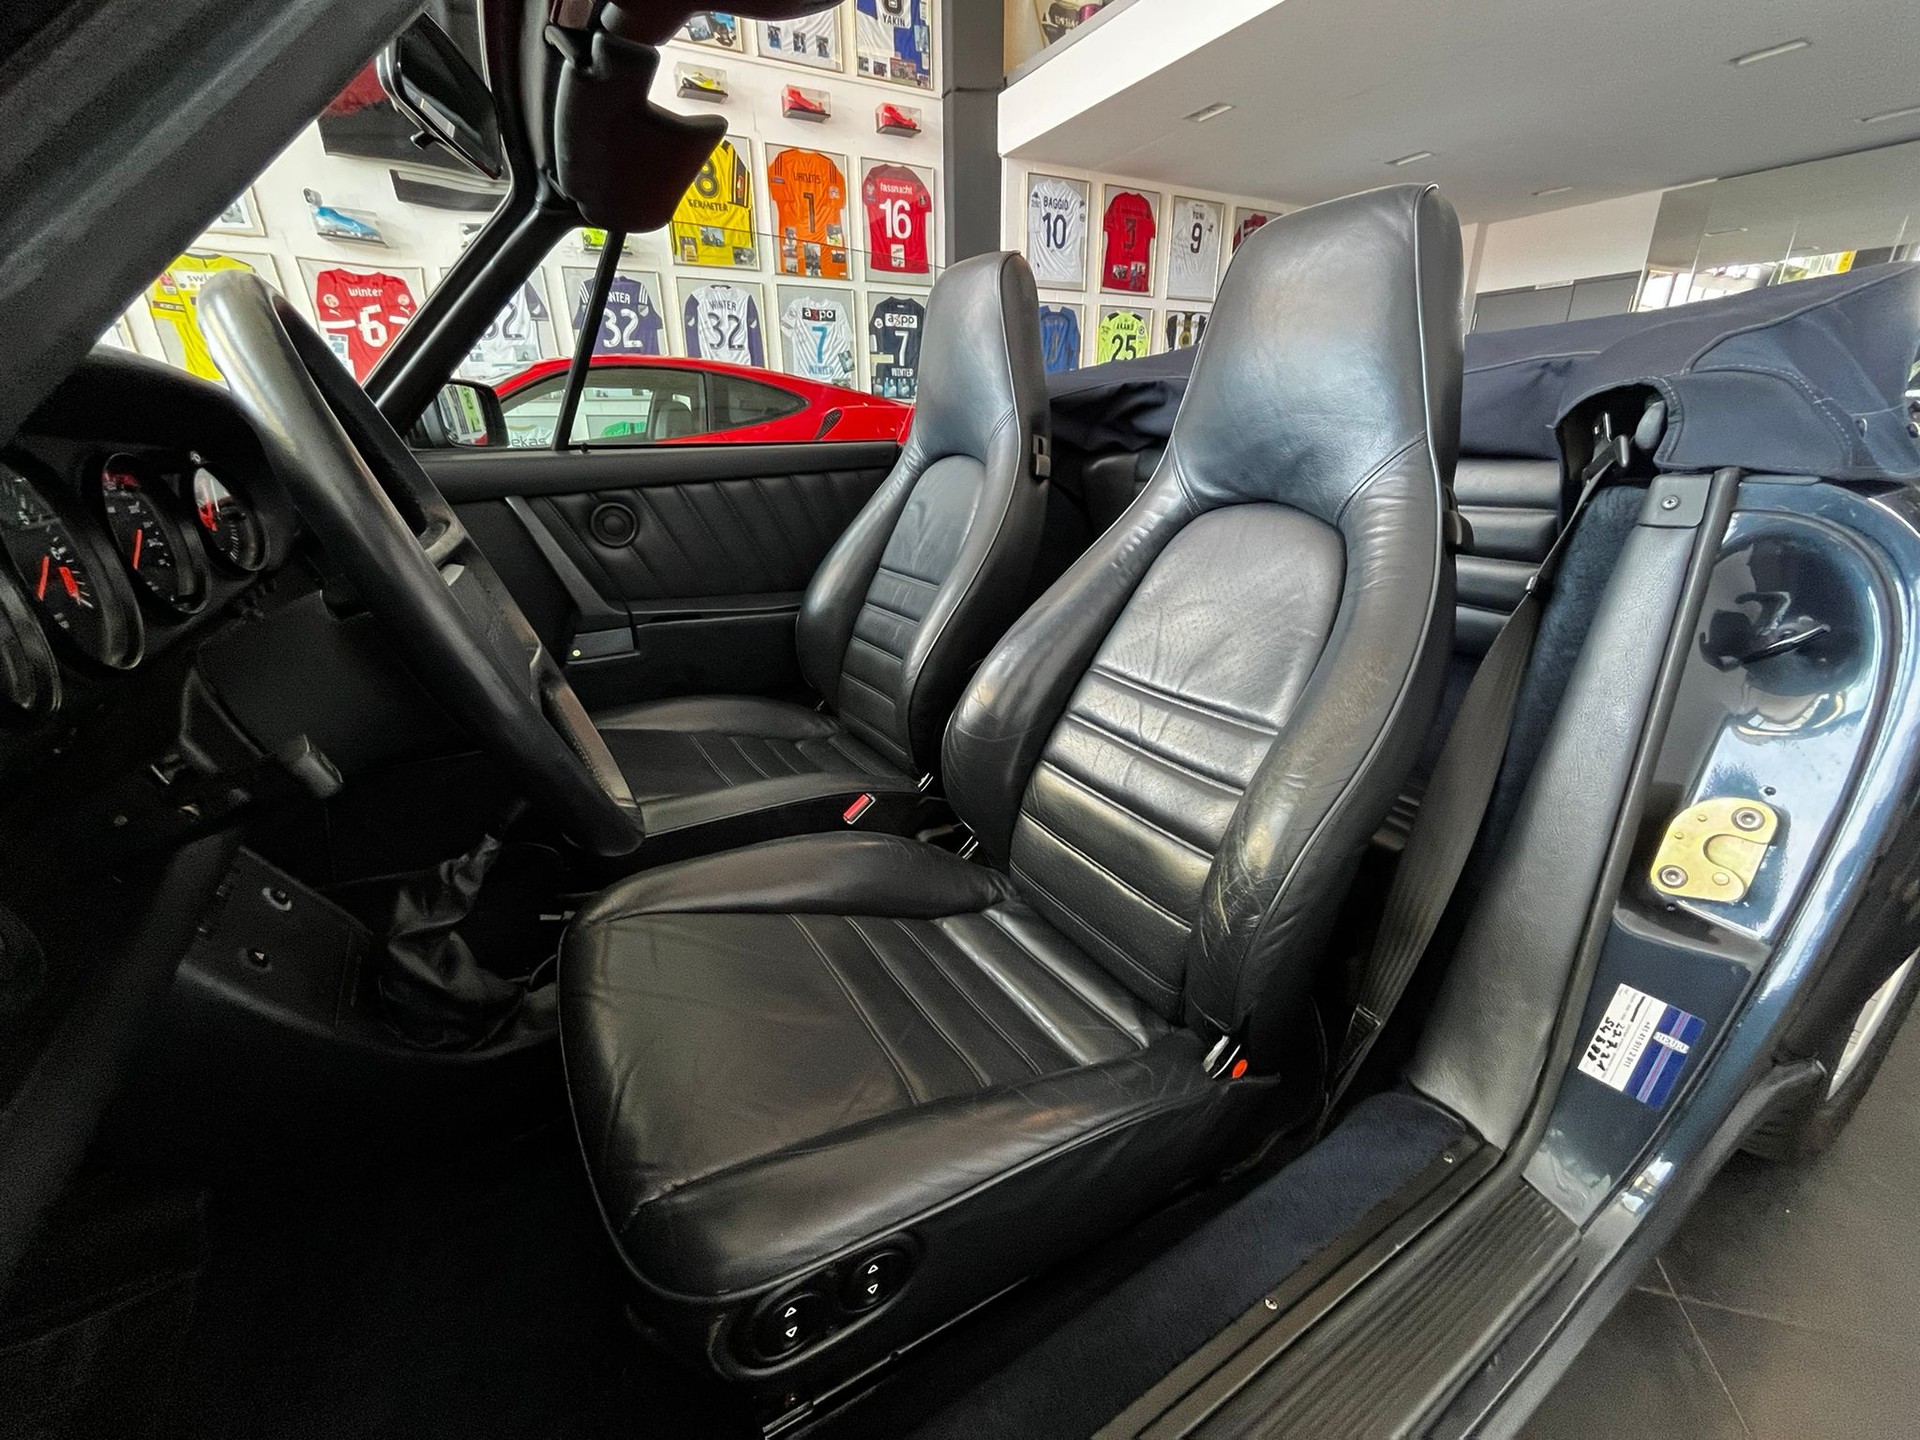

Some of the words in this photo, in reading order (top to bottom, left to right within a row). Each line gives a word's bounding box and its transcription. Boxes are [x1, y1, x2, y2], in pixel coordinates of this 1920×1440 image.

[882, 13, 906, 27] YAKIN
[694, 158, 720, 199] 8
[803, 192, 816, 234] 1
[879, 198, 912, 240] 16
[1043, 196, 1069, 211] BAGGIO
[1042, 212, 1067, 249] 10
[1190, 222, 1203, 254] 9
[347, 288, 384, 297] winter
[608, 291, 631, 304] NTER
[708, 299, 737, 311] WINTER
[358, 304, 388, 348] 6
[603, 308, 643, 348] 32
[803, 308, 835, 321] axpo
[887, 314, 915, 327] axpo
[707, 312, 745, 350] 32
[811, 325, 828, 364] 7
[895, 330, 909, 367] 7
[1111, 334, 1137, 361] 25
[891, 367, 914, 378] WINTER
